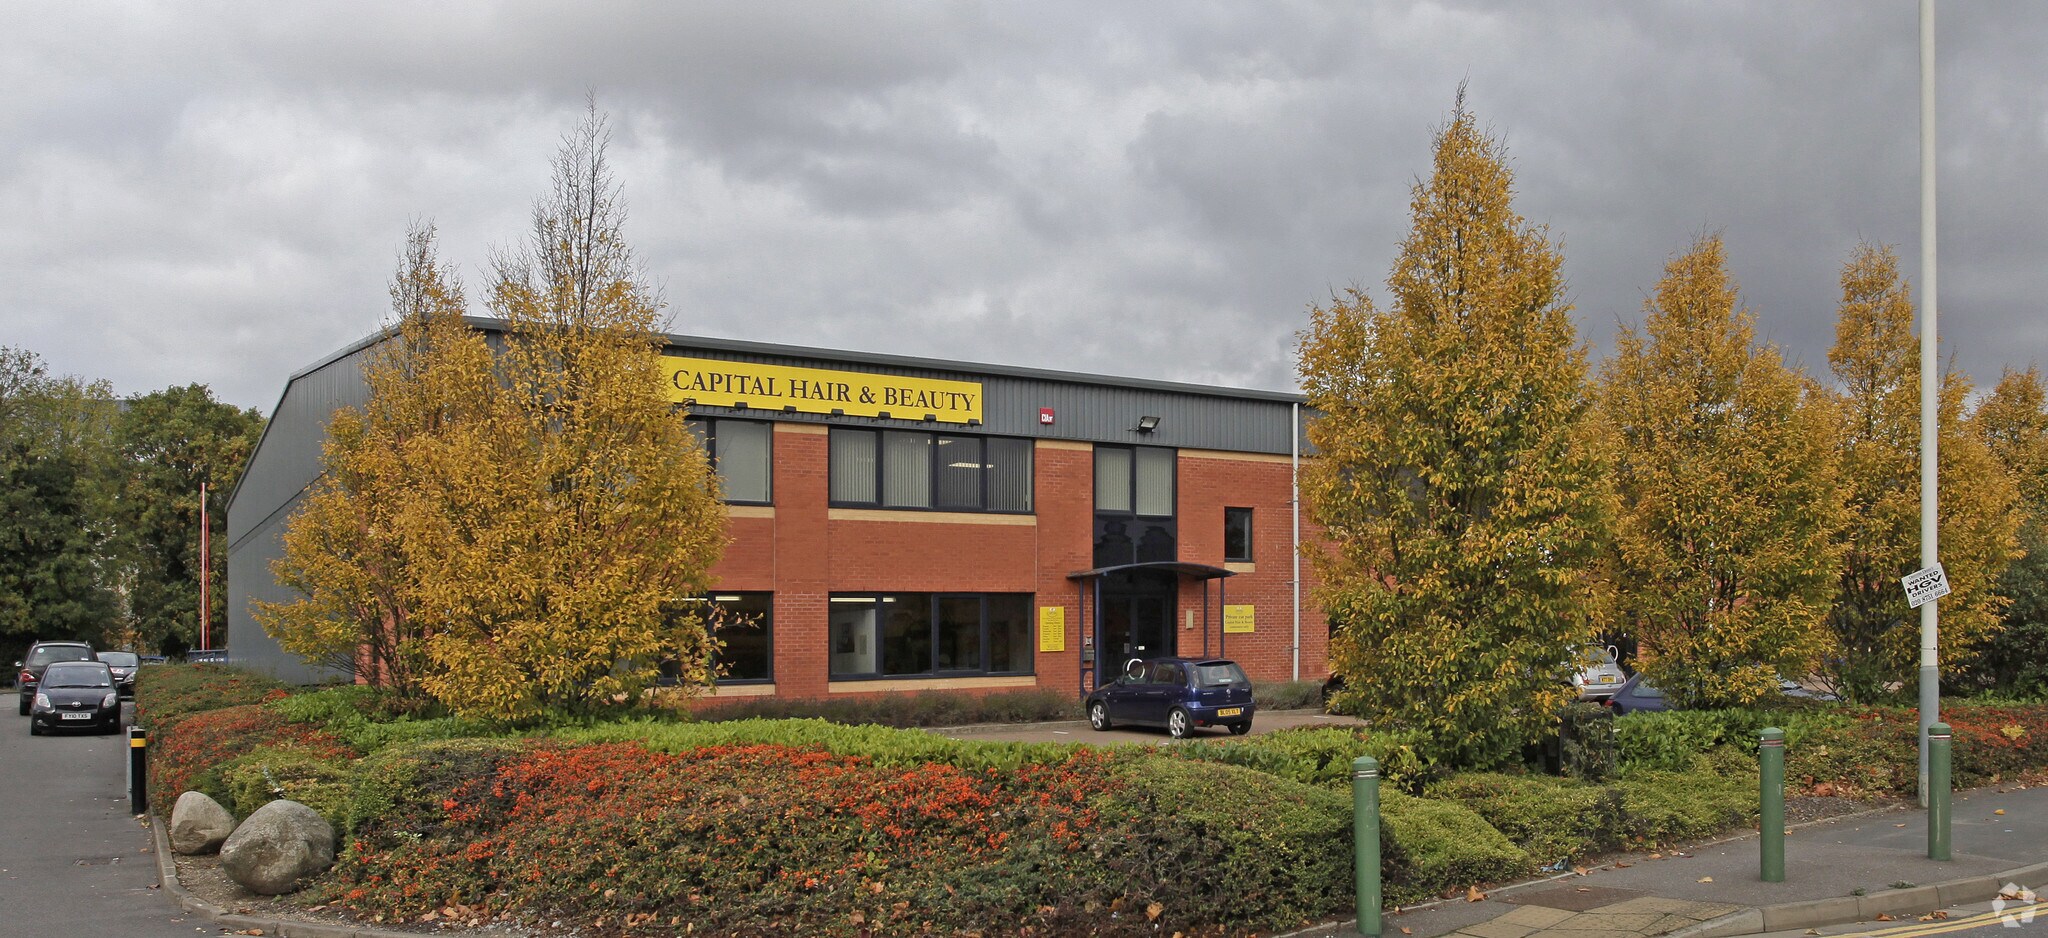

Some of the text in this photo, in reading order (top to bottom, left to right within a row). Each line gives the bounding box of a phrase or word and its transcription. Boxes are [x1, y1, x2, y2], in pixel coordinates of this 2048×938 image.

[673, 369, 976, 412] CAPITAL HAIR & BEAUTY
[1906, 575, 1942, 593] HGV
[1907, 570, 1939, 586] WANTED
[1911, 582, 1942, 598] DRIVERS
